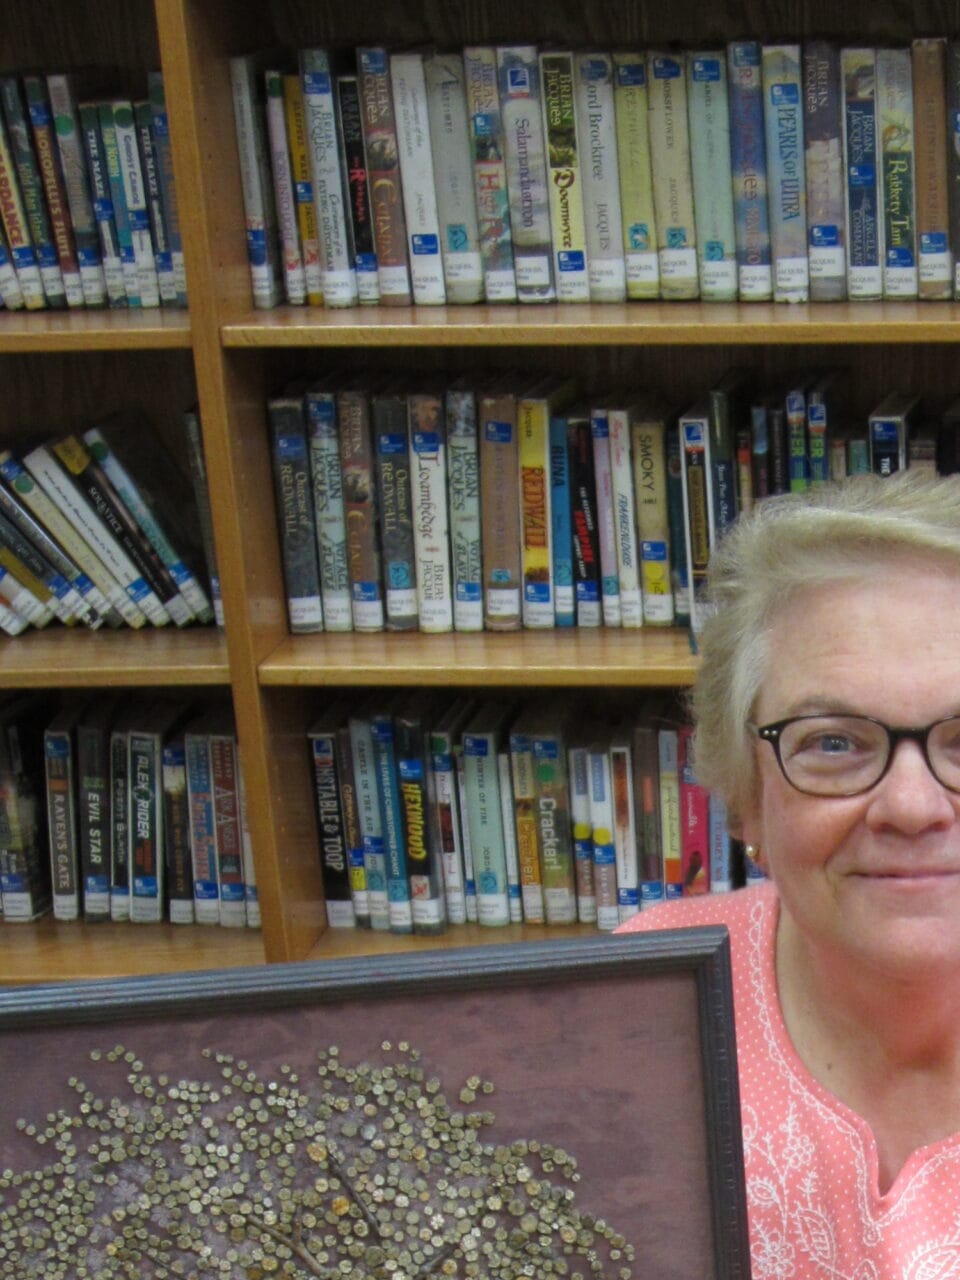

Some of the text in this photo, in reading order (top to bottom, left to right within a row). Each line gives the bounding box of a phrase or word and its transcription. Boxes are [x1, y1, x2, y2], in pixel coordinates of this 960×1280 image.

[559, 74, 571, 119] BRIAN
[309, 102, 325, 163] JACQUES
[325, 111, 334, 149] BRIAN
[588, 112, 605, 182] Brocktree
[778, 107, 797, 161] PEARLS
[849, 110, 863, 163] JACQUES
[863, 114, 873, 153] BRIAN
[92, 161, 104, 198] MAZE
[516, 117, 536, 228] Salamandastron
[780, 178, 800, 221] LUTRA
[891, 216, 910, 245] Tam
[328, 452, 341, 500] BRIAN
[463, 451, 476, 498] BRIAN
[638, 434, 655, 492] SMOKY
[418, 451, 439, 540] Loamhedge
[521, 465, 547, 551] REDWALL
[135, 755, 150, 796] ALEX
[53, 794, 70, 889] RAVEN'S GATE
[87, 792, 102, 865] EVIL STAR
[137, 796, 150, 839] RIDER
[315, 758, 344, 871] ONSTABLE TOOP
[403, 783, 427, 861] HEXWOOD
[539, 798, 561, 870] Cracker!
